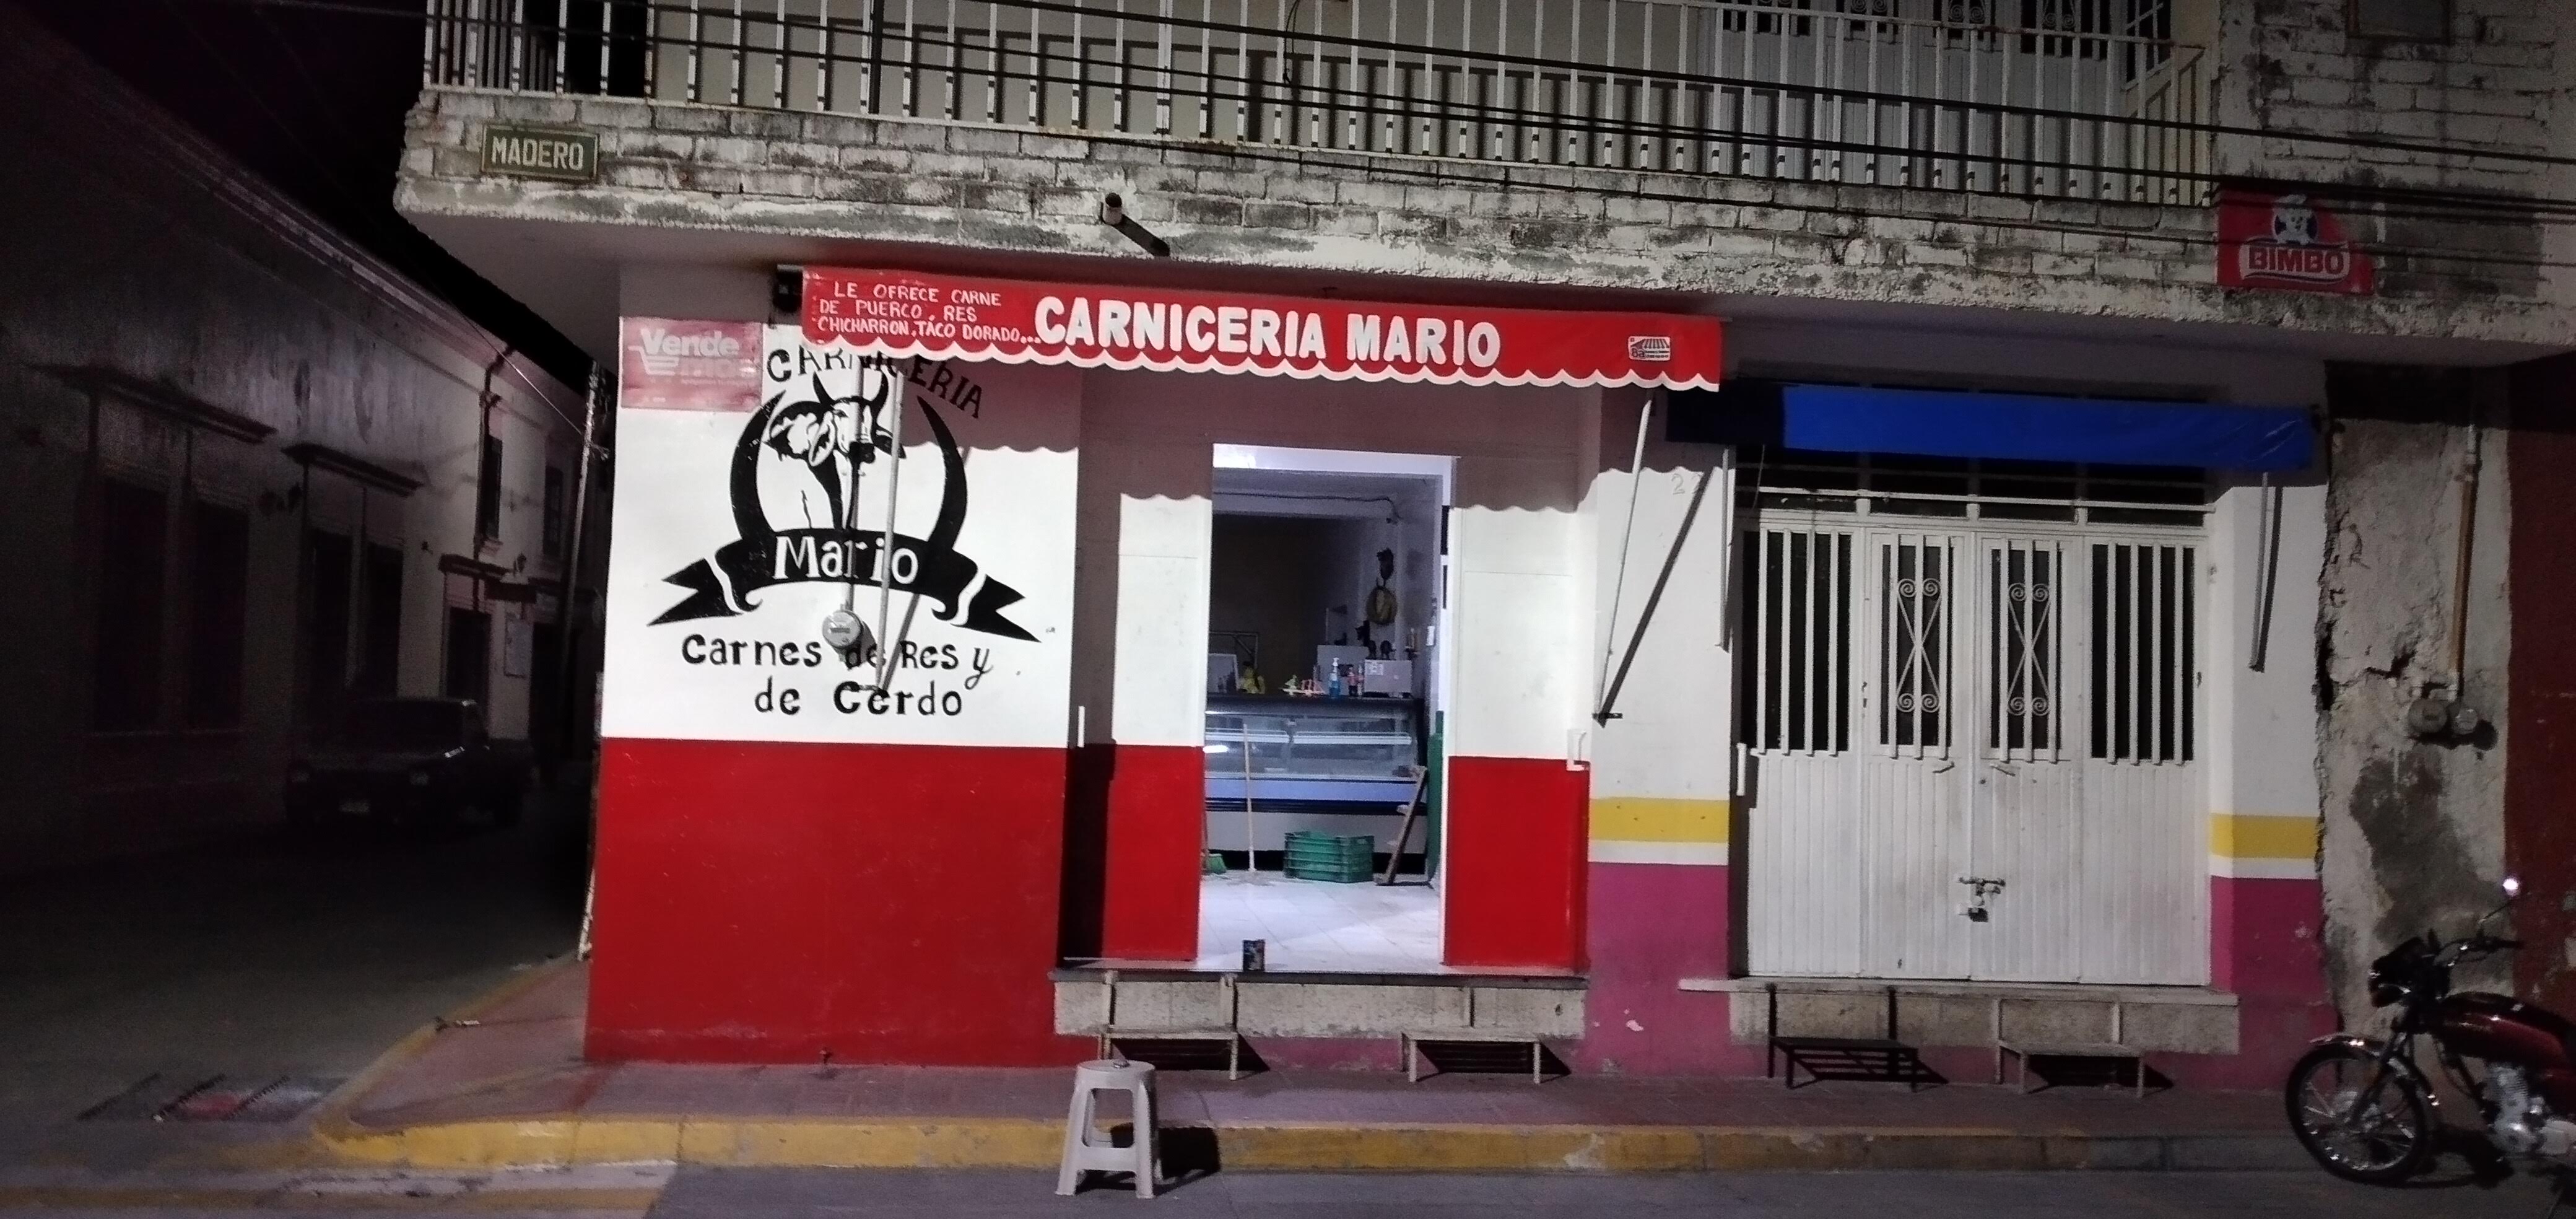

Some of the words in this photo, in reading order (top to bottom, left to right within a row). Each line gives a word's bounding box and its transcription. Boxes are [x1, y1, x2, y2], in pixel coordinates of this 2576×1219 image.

[492, 136, 584, 171] MADERO
[2248, 248, 2344, 274] BIMBO
[819, 299, 840, 314] DE
[943, 304, 977, 322] RES
[834, 281, 858, 298] LE
[873, 283, 939, 303] OFRECE
[951, 289, 1001, 307] CARNE
[640, 328, 740, 357] Vende
[1035, 295, 1326, 359] CARNICERIA
[1347, 313, 1501, 367] MARIO
[772, 536, 918, 584] Mario
[682, 634, 822, 667] Carnes
[900, 640, 959, 669] Res
[965, 647, 993, 689] y
[754, 676, 801, 715] de
[833, 680, 962, 715] Cerdo
